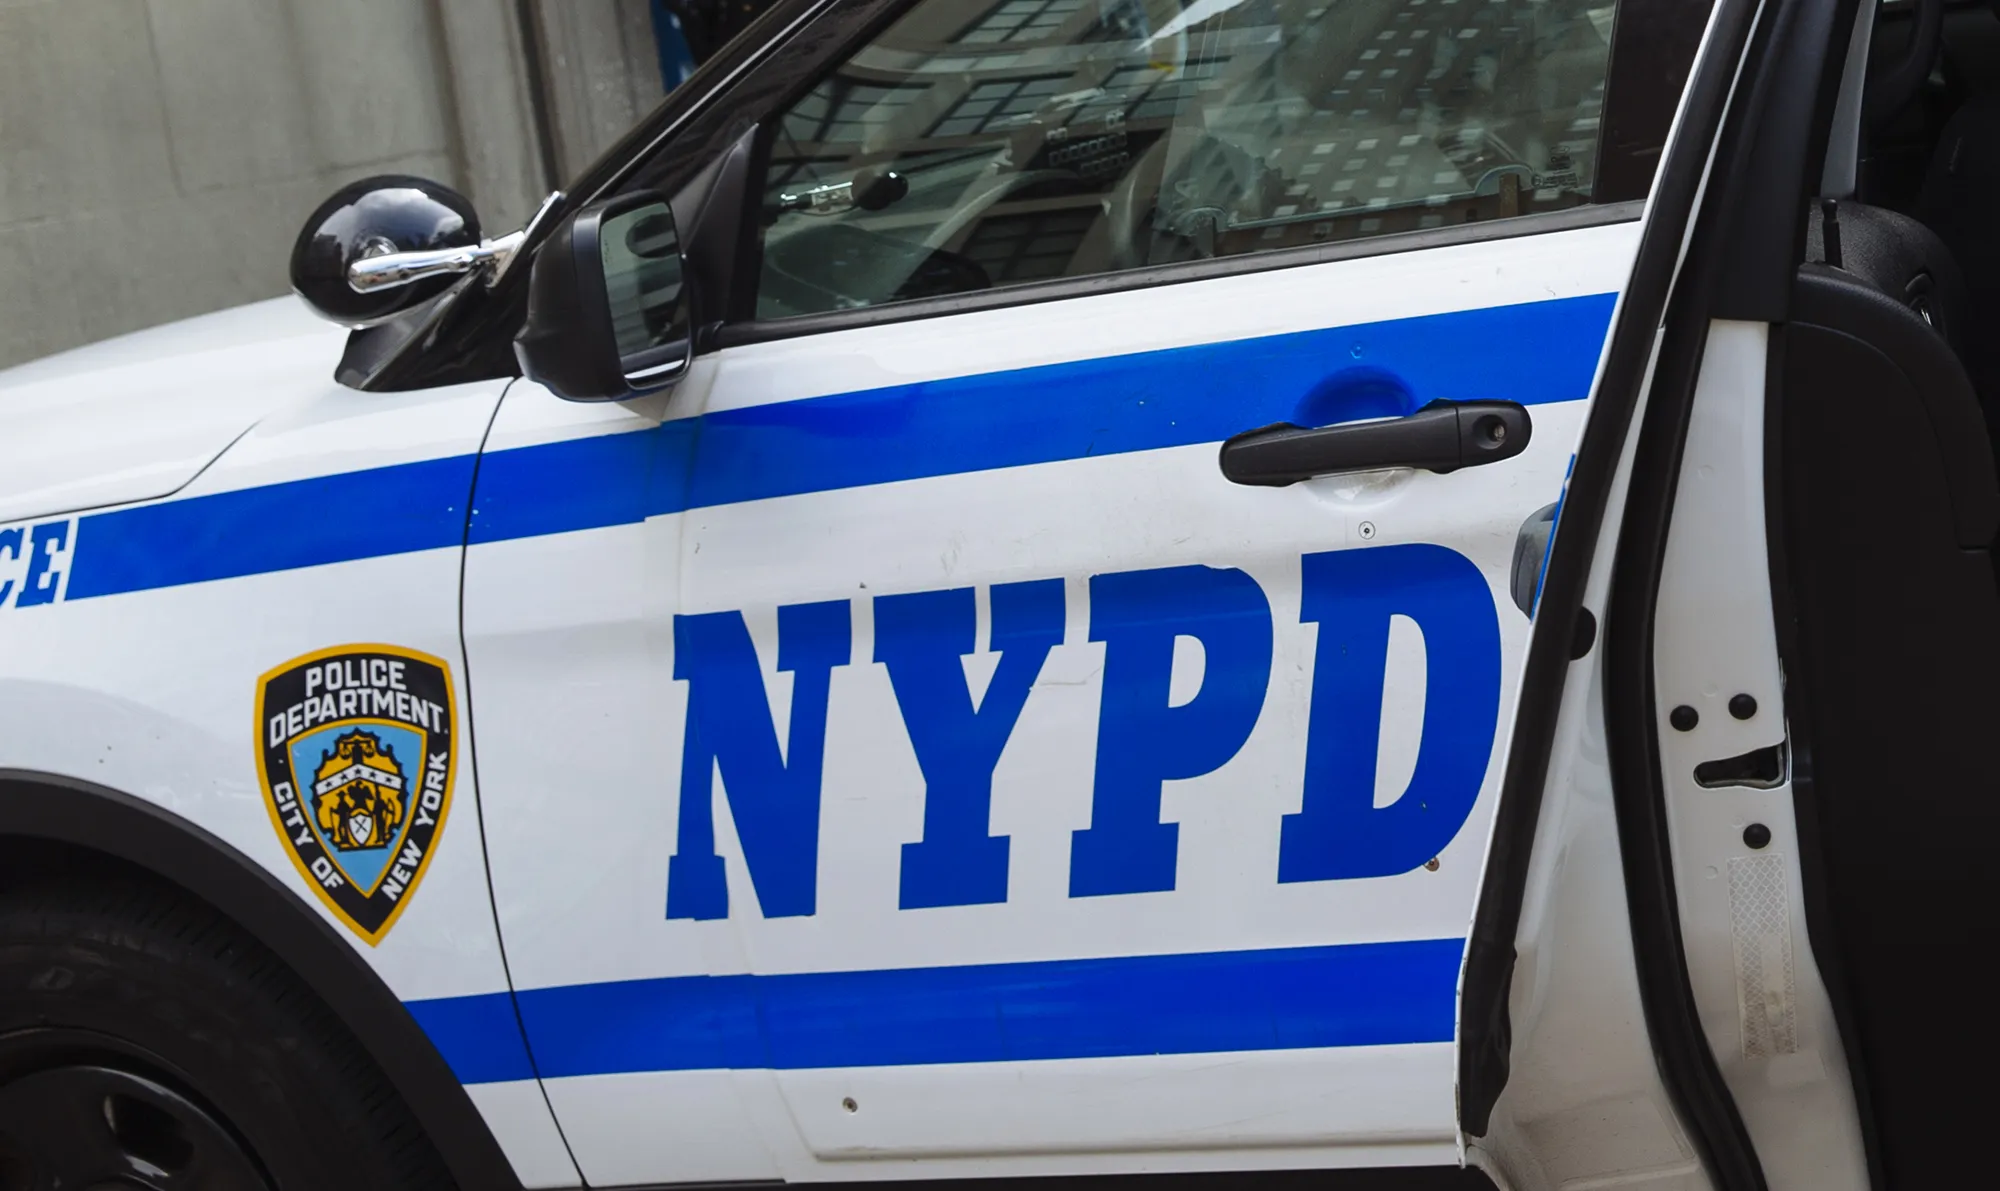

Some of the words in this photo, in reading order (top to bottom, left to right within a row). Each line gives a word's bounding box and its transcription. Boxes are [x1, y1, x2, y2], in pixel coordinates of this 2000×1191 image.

[270, 688, 444, 748] DEPARTMENT
[306, 659, 407, 698] POLICE
[666, 543, 1502, 921] NYPD
[274, 781, 315, 846] CITY
[311, 856, 345, 888] OF
[381, 838, 423, 901] NEW
[416, 751, 448, 827] YORK
